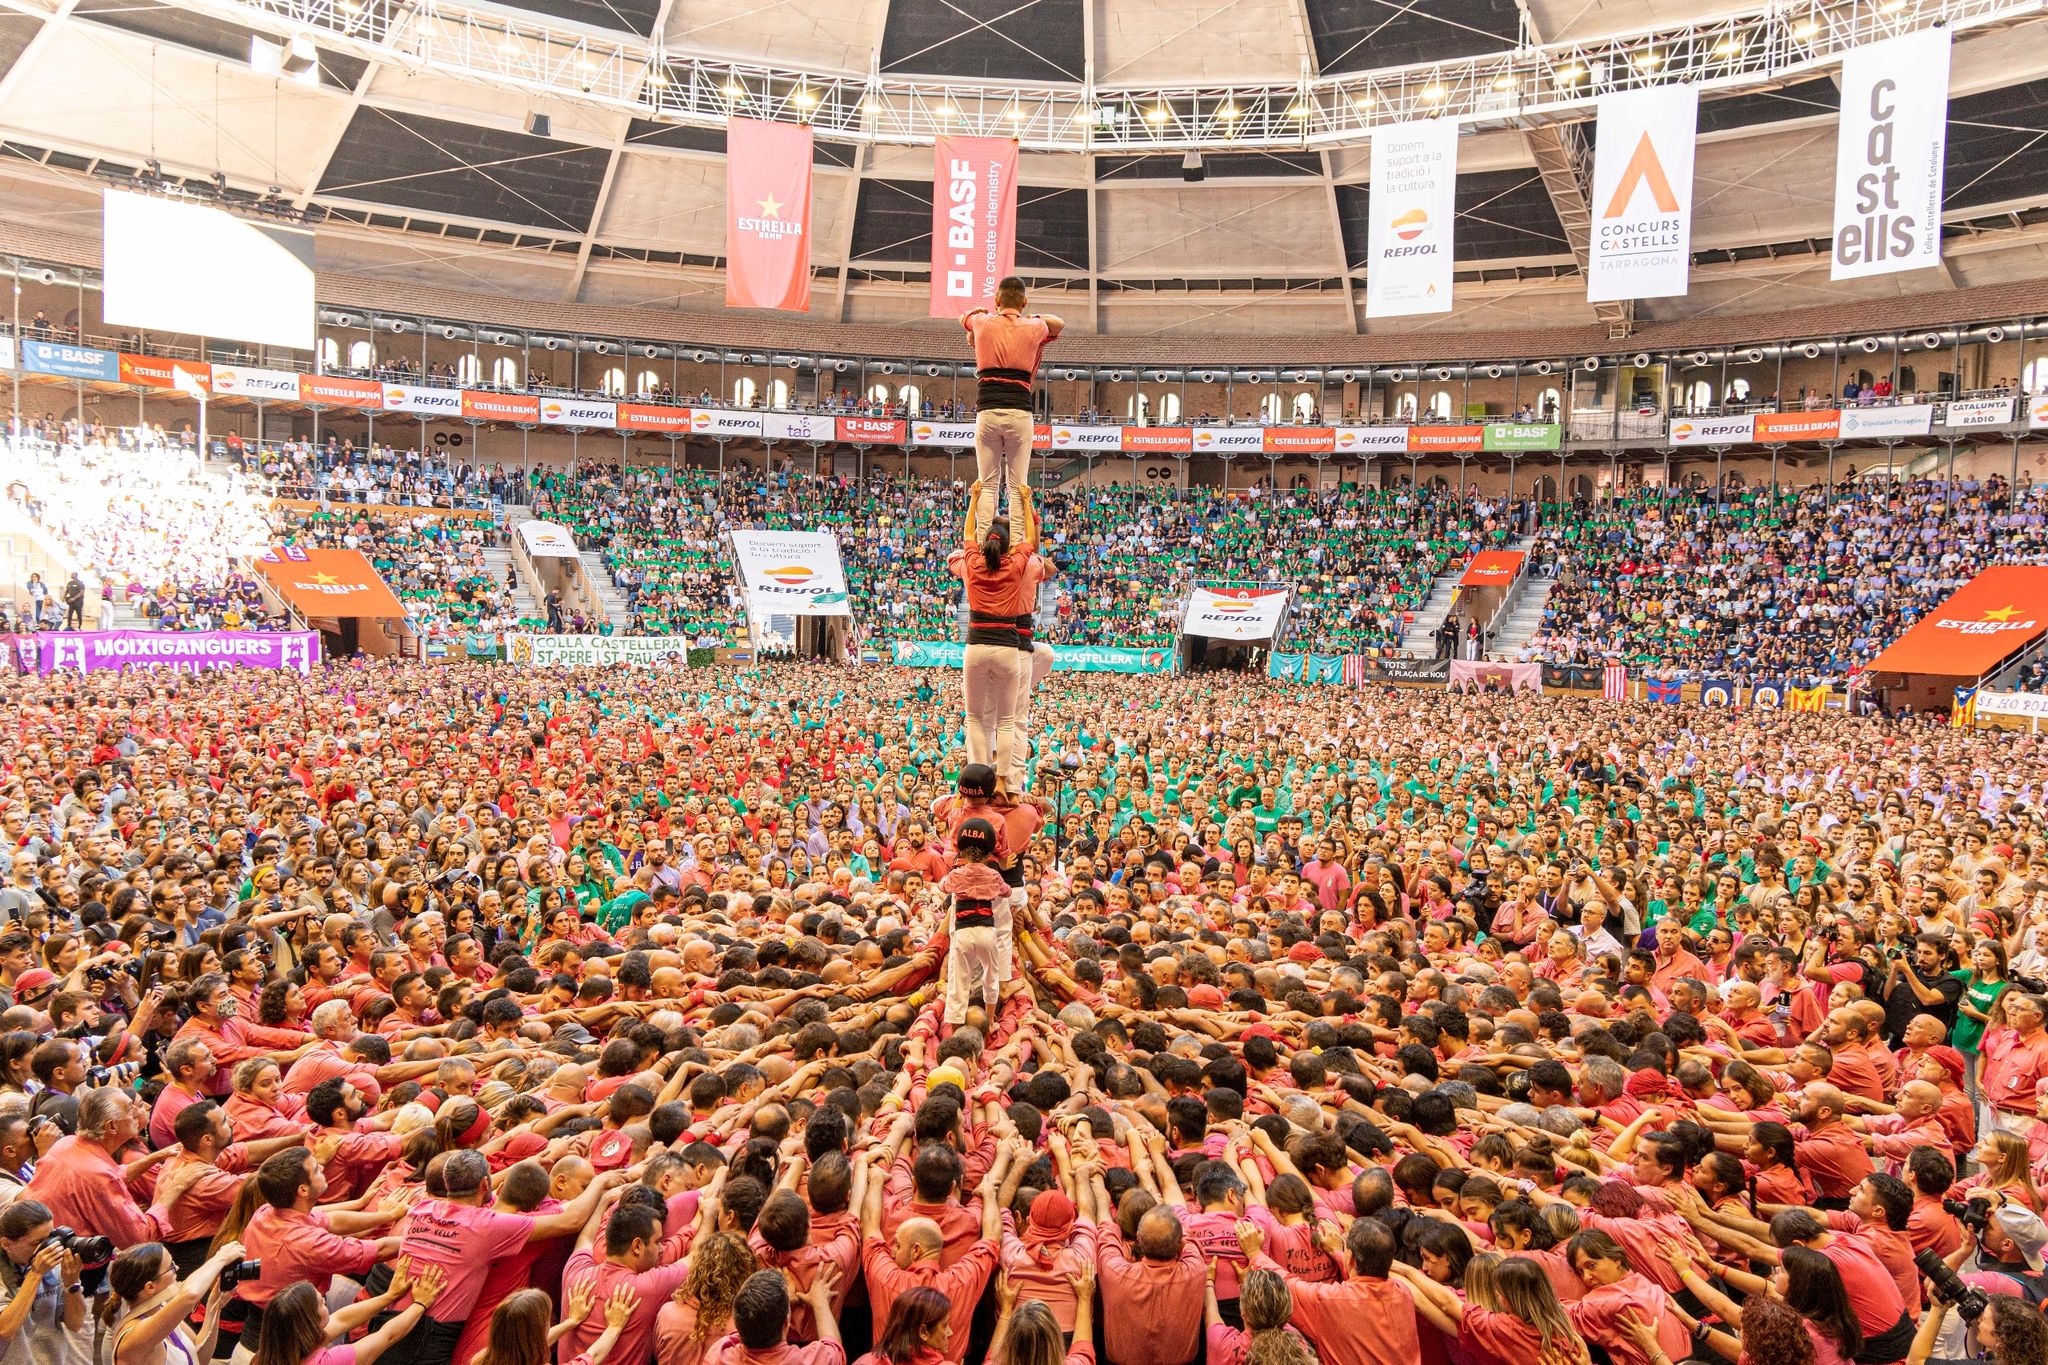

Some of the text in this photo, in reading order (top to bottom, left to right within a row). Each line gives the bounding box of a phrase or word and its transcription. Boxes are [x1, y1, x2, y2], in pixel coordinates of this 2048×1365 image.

[1388, 142, 1424, 153] Donem
[1387, 152, 1442, 167] suport a la
[1387, 166, 1424, 180] tradició
[1386, 180, 1434, 194] la cultura
[1930, 178, 1936, 188] de
[948, 159, 976, 248] BASF
[738, 217, 802, 235] ESTRELLA
[982, 160, 1002, 298] We create chemistry
[1601, 220, 1680, 236] CONCURS
[758, 232, 782, 240] DAMM
[1600, 234, 1679, 250] CASTELLS
[1384, 244, 1438, 258] REPSOL
[1600, 256, 1678, 270] TARRAGONA
[62, 348, 104, 365] BASF
[134, 367, 173, 379] ESTRELL
[246, 378, 296, 392] REPSOL
[314, 387, 380, 400] ESTRELLA DAMM
[414, 395, 460, 408] REPSOL
[1952, 401, 2008, 412] CATALUNYA
[474, 402, 537, 415] ESTRELLA DAMM
[570, 409, 614, 420] REPSOL
[630, 415, 690, 425] ESTRELLA DAMM
[718, 418, 761, 429] REPSOL
[864, 421, 895, 432] BASF
[1768, 421, 1838, 432] ESTRELLA DAMM
[787, 424, 811, 438] tac
[938, 430, 976, 440] REPSO
[1513, 428, 1548, 438] BASF
[1701, 425, 1751, 436] REPSOL
[1078, 434, 1120, 443] REPSOL
[1134, 436, 1168, 444] ESTRELLA
[1219, 436, 1262, 444] REPSOL
[1274, 437, 1310, 445] ESTRELLA
[1362, 436, 1406, 444] REPSOL
[1420, 436, 1481, 444] ESTRELLA DAMM
[749, 540, 786, 548] Donem
[293, 582, 370, 591] ESTRELLA
[758, 584, 835, 594] REPSOL
[1202, 614, 1262, 622] REPSOL
[1935, 619, 2036, 630] ESTRELLA
[94, 639, 272, 657] MOIXIGANGUERS
[536, 637, 680, 650] COLLA CASTELLERA
[538, 651, 552, 663] ST
[560, 651, 592, 663] PERE
[604, 651, 618, 664] ST
[626, 653, 650, 664] PAU
[1394, 670, 1418, 678] PLAÇA
[959, 785, 984, 796] ADRIÀ
[961, 828, 985, 840] ALBA
[408, 1227, 460, 1238] COLLA VELLA
